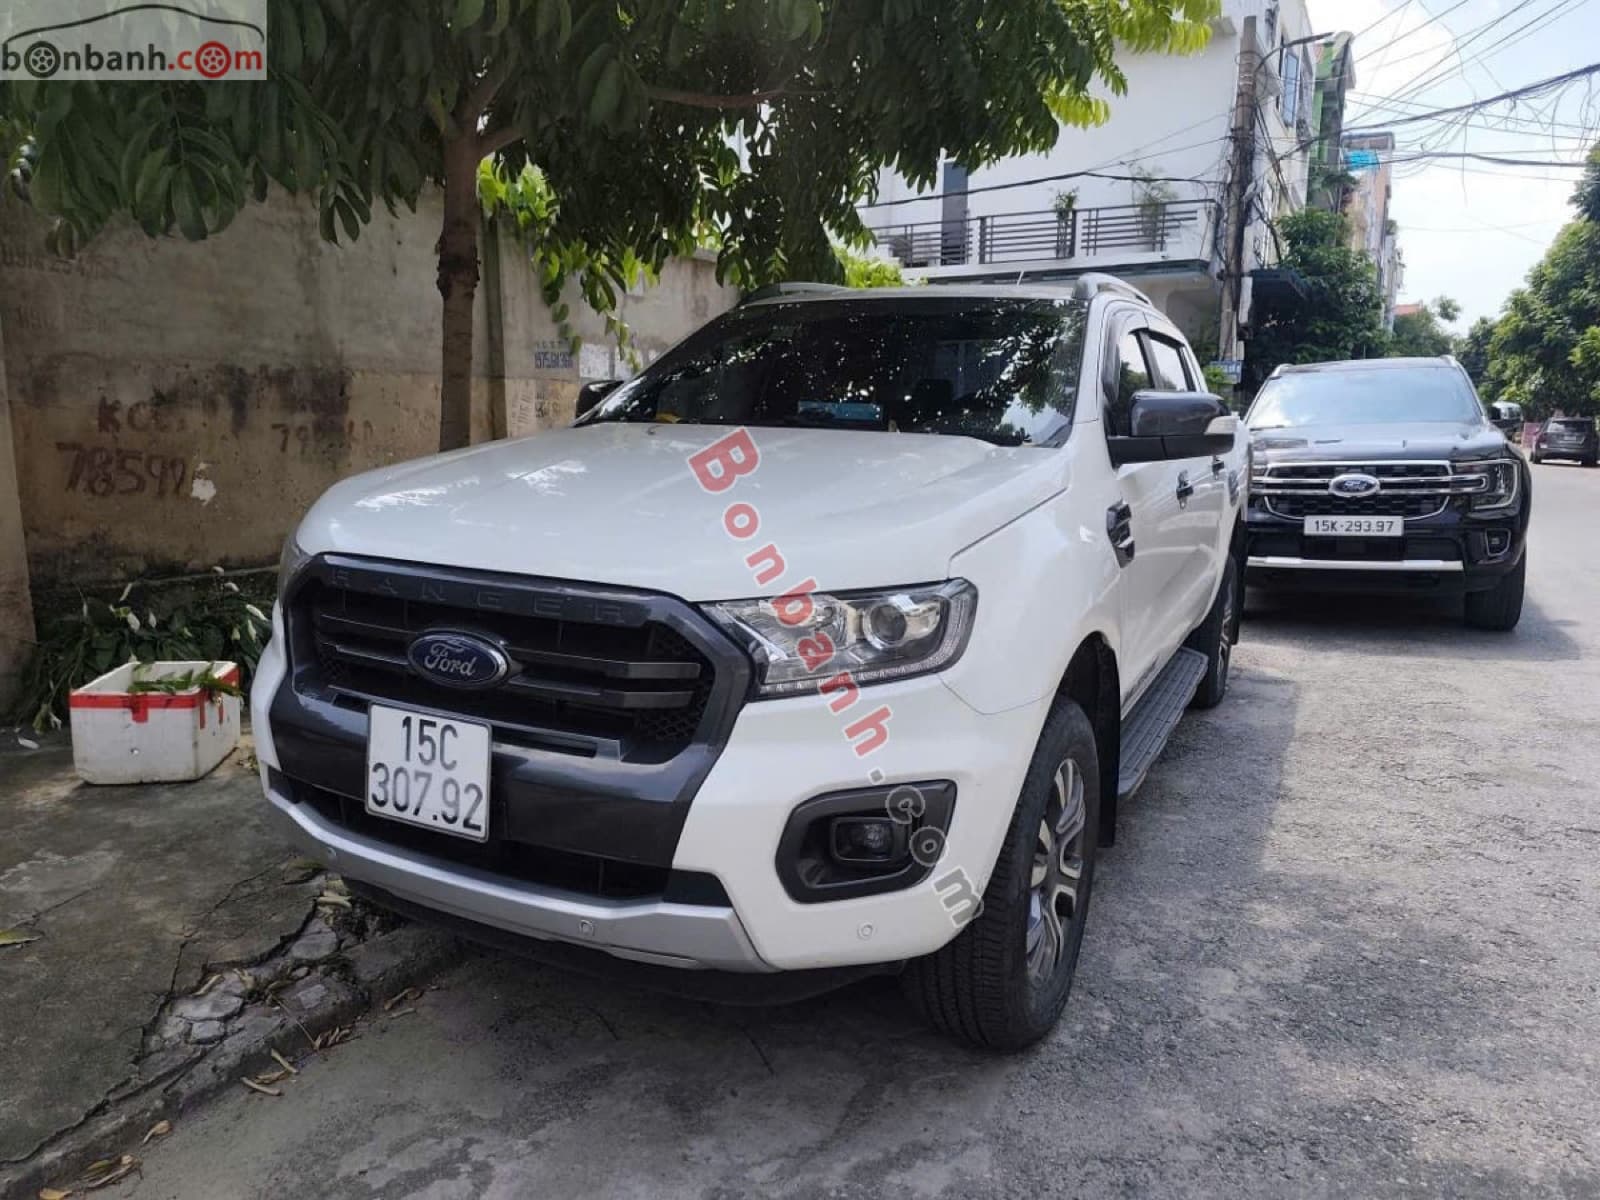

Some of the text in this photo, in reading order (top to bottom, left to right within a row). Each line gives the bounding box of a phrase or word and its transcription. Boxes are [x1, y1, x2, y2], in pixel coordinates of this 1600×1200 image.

[1314, 519, 1395, 533] 15K-293.97
[331, 567, 626, 622] RANGER
[424, 637, 477, 677] Ford
[401, 715, 459, 771] 15C
[371, 762, 484, 832] 307.92
